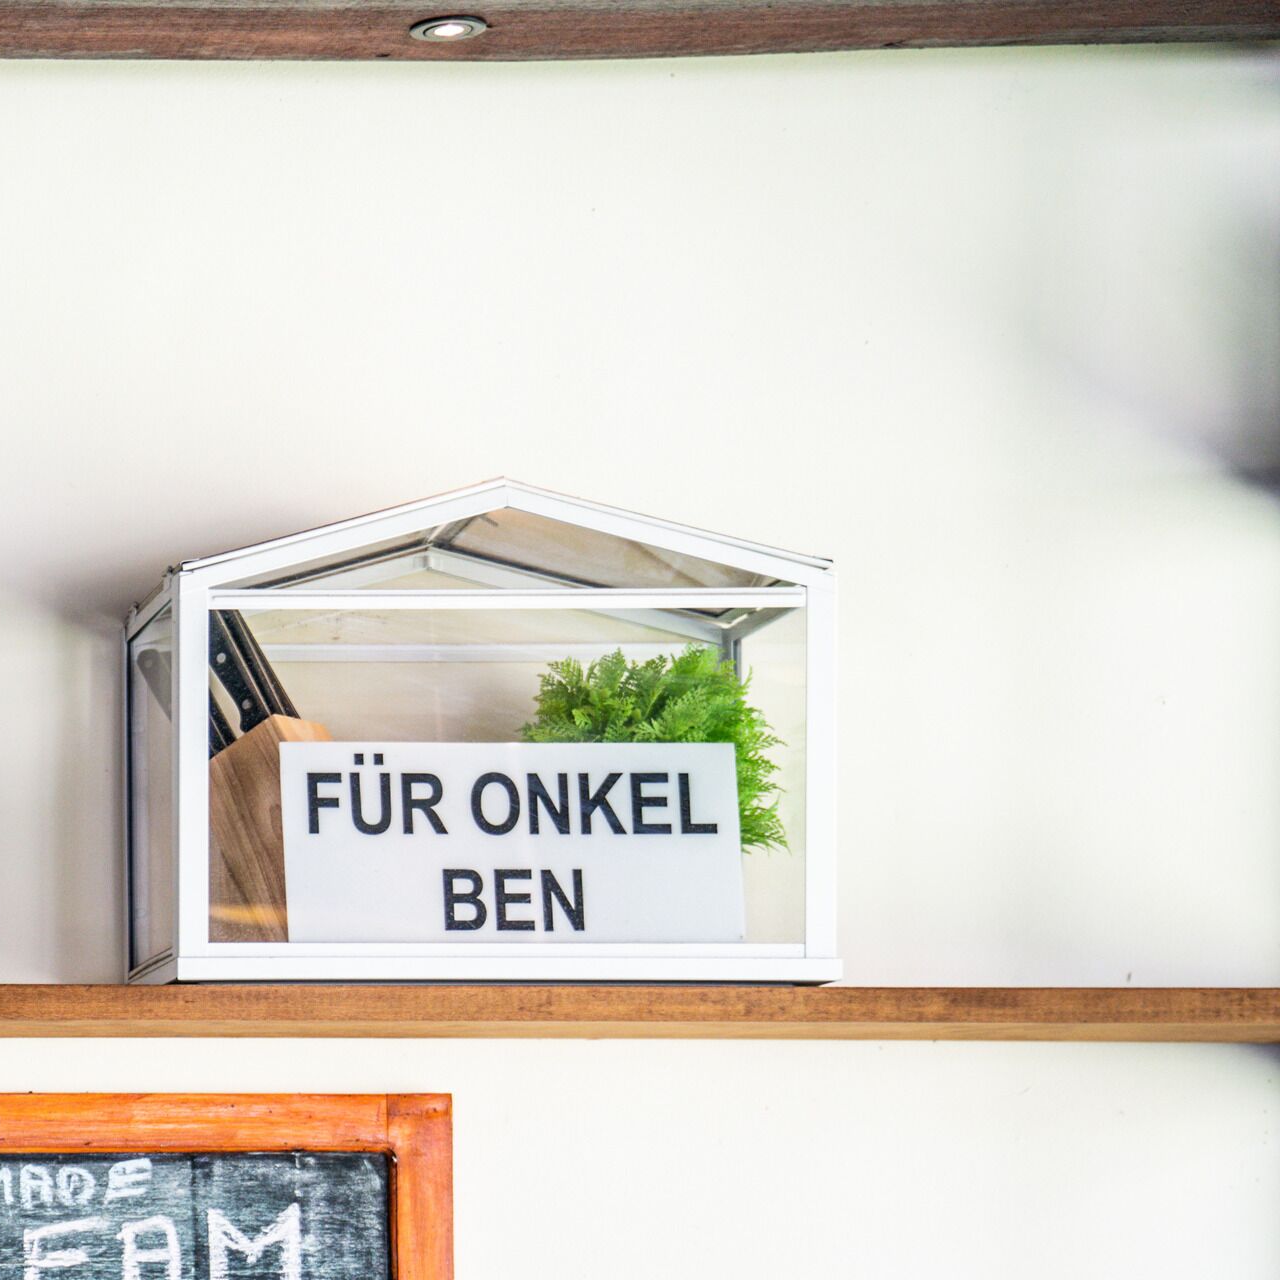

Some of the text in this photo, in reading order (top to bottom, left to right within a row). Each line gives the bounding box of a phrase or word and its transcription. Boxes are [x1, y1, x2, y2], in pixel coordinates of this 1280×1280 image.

[306, 753, 718, 836] FÜR ONKEL
[443, 868, 586, 932] BEN
